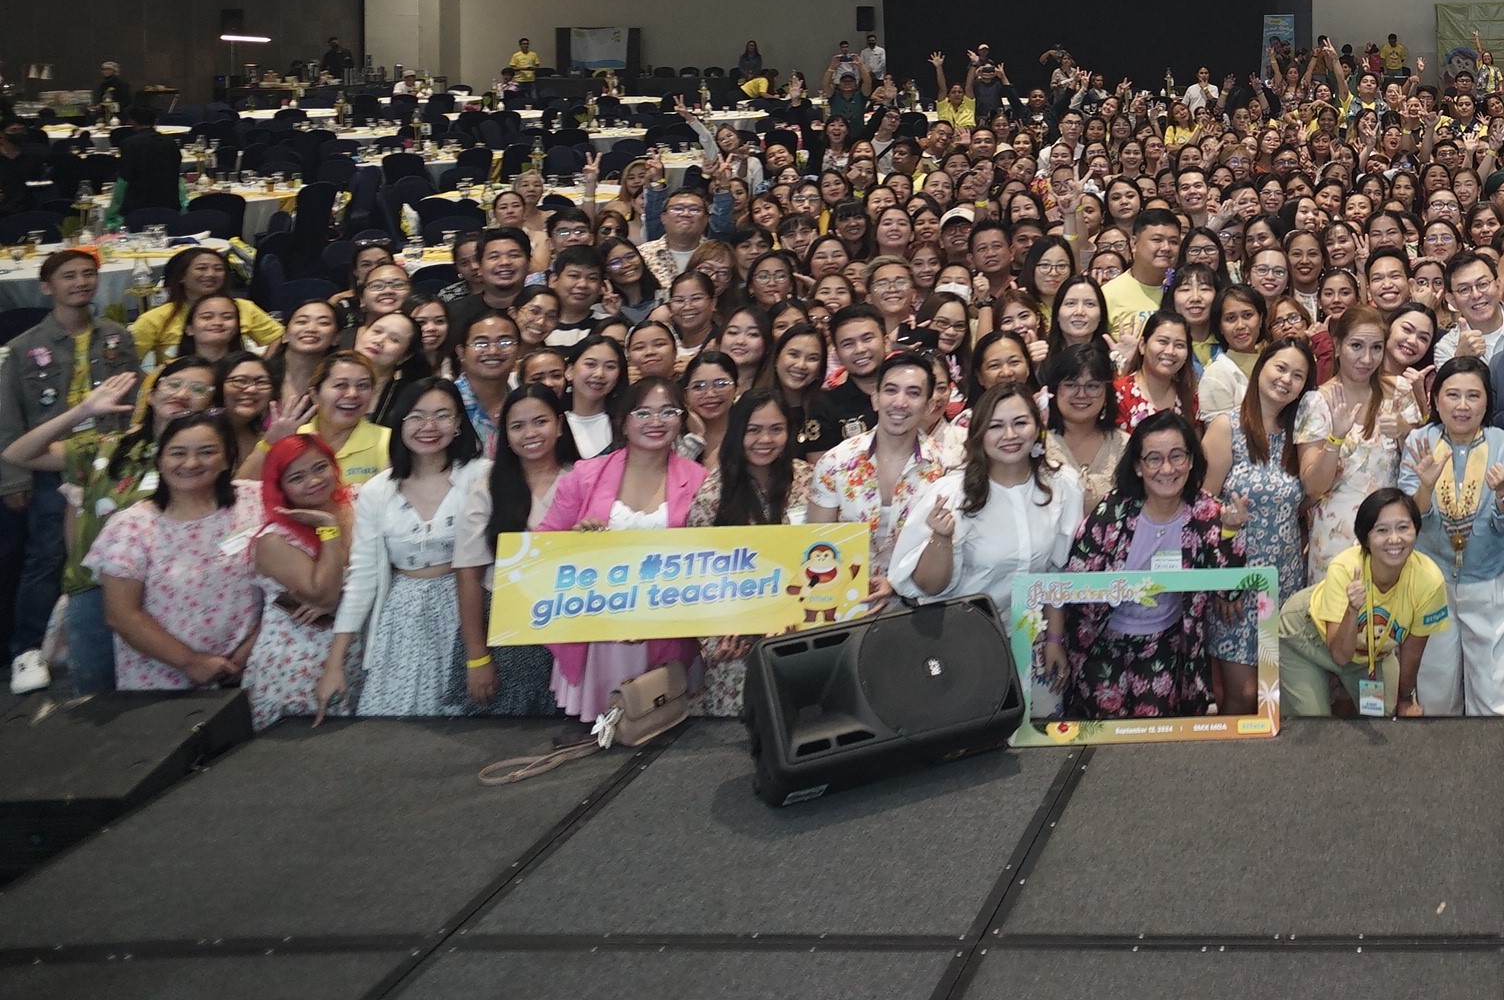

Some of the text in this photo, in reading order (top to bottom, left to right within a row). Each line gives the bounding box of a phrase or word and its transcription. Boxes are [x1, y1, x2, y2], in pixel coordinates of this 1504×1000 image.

[555, 547, 759, 590] Be a #51Talk
[530, 567, 781, 629] global teacher!
